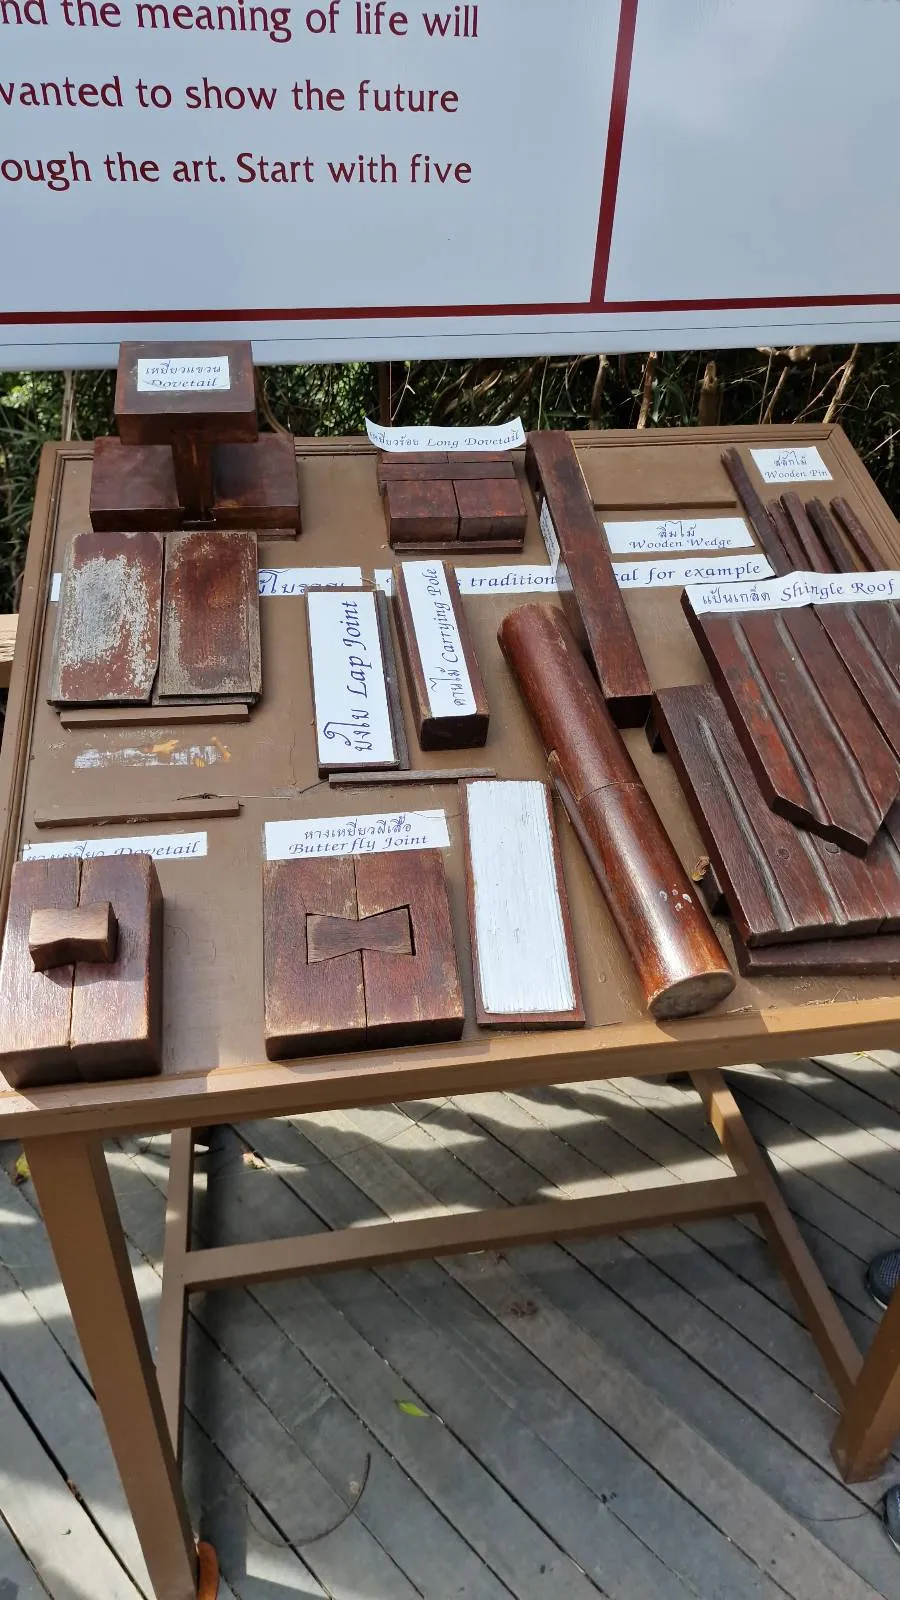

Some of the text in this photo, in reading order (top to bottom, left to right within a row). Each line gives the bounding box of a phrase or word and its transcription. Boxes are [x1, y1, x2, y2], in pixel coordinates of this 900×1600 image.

[60, 0, 121, 27] the
[137, 0, 291, 42] meaning
[305, 1, 339, 33] of
[355, 2, 408, 35] life
[422, 4, 478, 37] will
[135, 78, 171, 108] to
[185, 77, 277, 109] show
[292, 80, 345, 111] the
[358, 80, 458, 112] future
[1, 151, 471, 191] ough the art. Start with five
[151, 378, 217, 388] Dovetail
[427, 438, 458, 448] Long
[464, 429, 520, 446] Dovetail
[764, 469, 828, 479] Wooden Pin
[629, 537, 733, 549] Wooden Wedge
[421, 568, 442, 597] Pole
[645, 567, 676, 584] for
[685, 561, 761, 580] example
[780, 577, 844, 601] Shingle
[851, 578, 894, 596] Roof
[339, 600, 367, 651] Joint
[433, 601, 459, 663] Carrying
[346, 655, 373, 698] Lap
[382, 834, 429, 850] Joint
